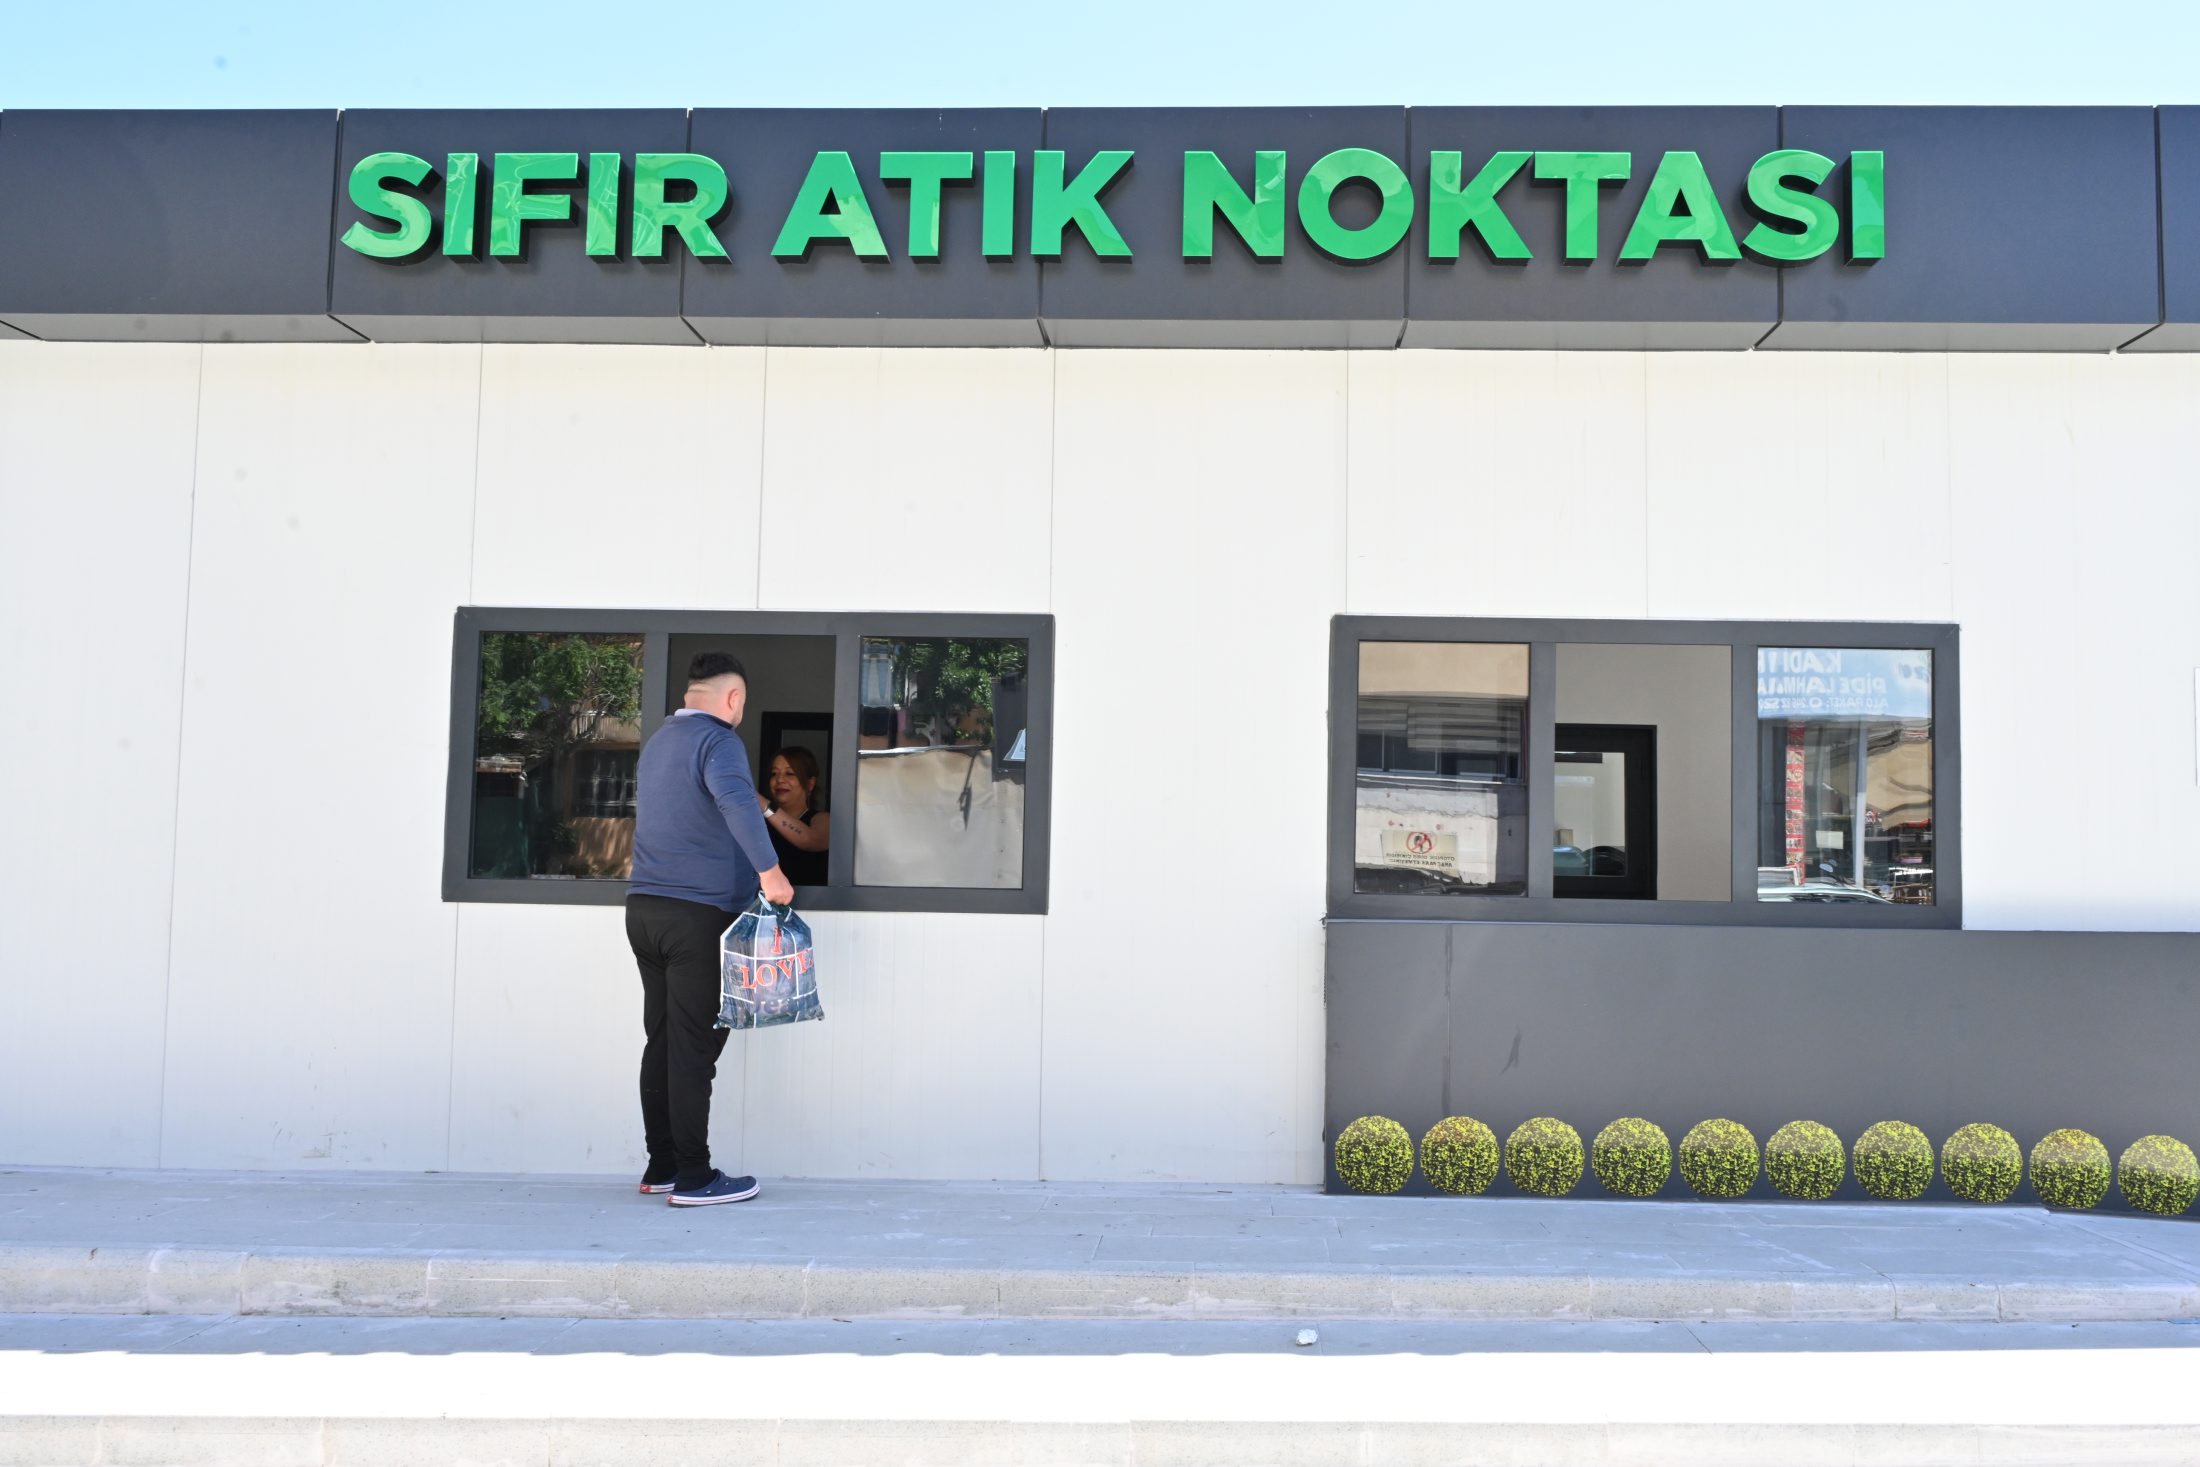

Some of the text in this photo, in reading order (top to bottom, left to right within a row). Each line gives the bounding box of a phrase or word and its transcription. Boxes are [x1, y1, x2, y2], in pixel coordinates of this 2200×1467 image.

[341, 148, 1887, 260] SIFIR ATIK NOKTASI
[771, 927, 782, 954] I
[740, 948, 813, 989] LOVE
